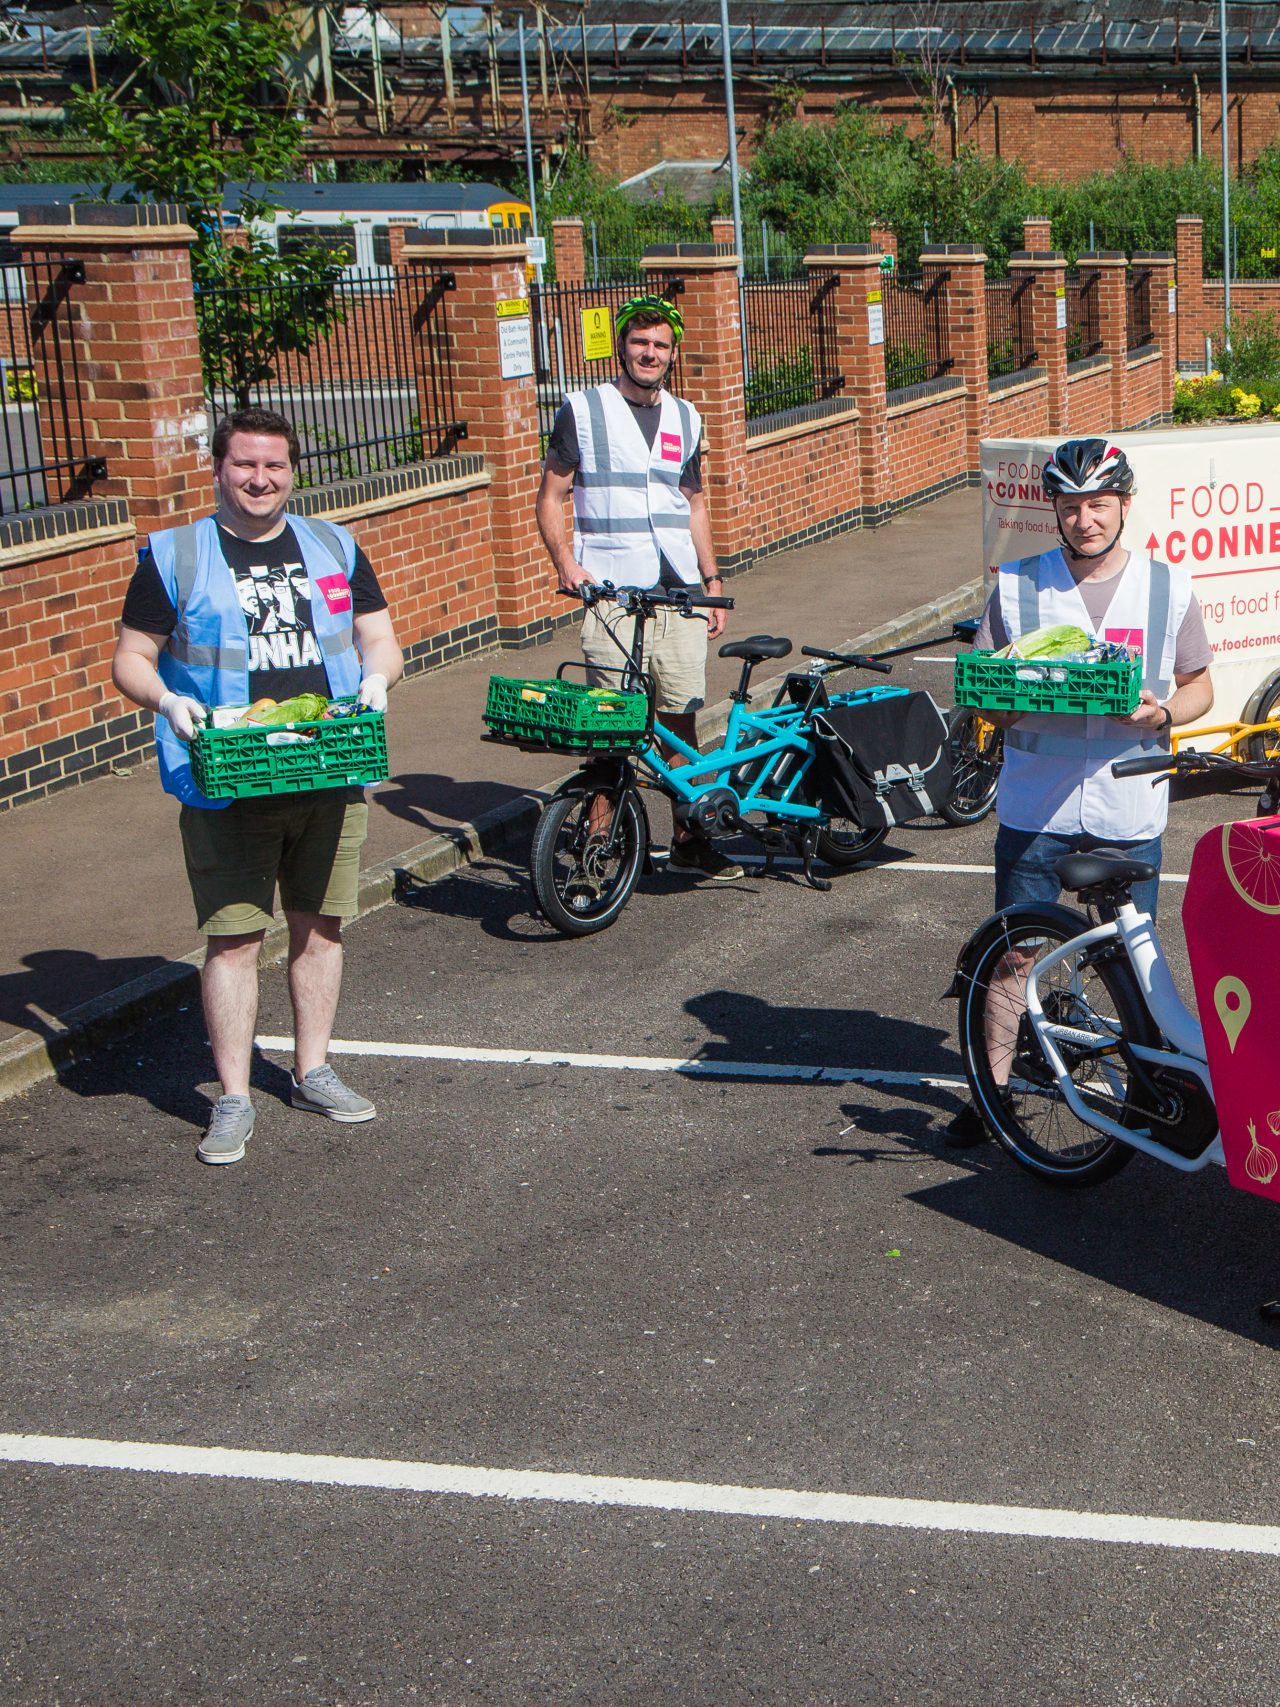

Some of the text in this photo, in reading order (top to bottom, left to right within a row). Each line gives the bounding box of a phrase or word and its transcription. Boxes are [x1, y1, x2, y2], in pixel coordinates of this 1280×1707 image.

[998, 461, 1040, 480] FOOD
[1169, 482, 1264, 519] FOOD
[998, 517, 1024, 533] Taking
[1025, 520, 1043, 533] food
[1200, 600, 1225, 623] ing
[1230, 592, 1268, 616] food
